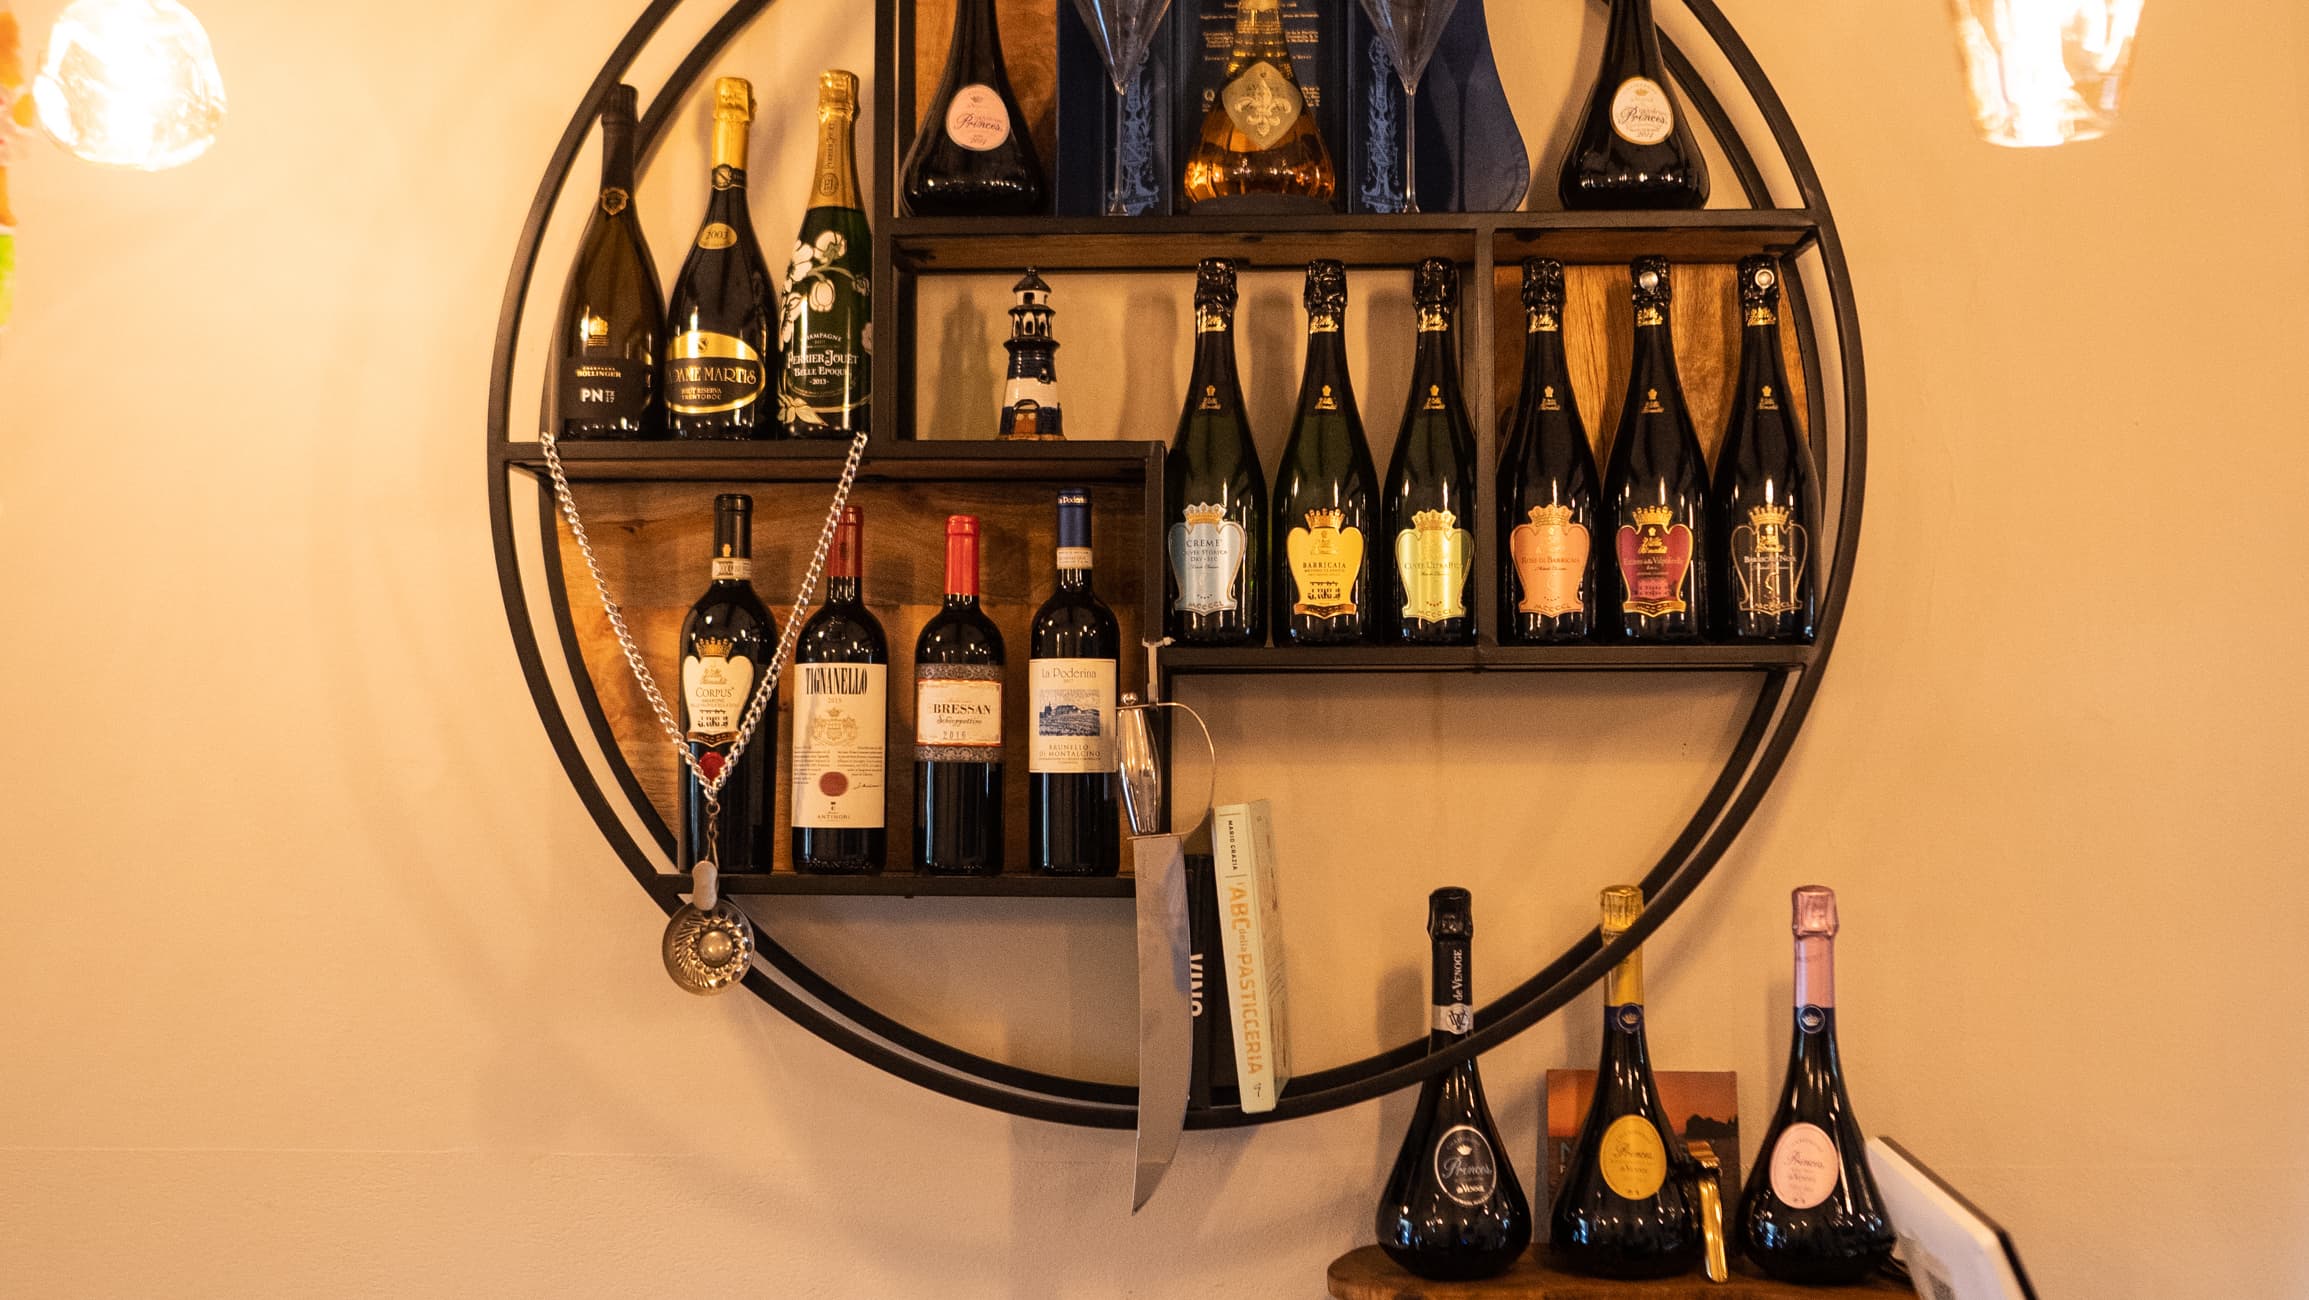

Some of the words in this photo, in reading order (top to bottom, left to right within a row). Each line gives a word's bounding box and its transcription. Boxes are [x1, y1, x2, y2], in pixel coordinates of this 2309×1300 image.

[576, 369, 621, 377] BOLLINGER
[704, 366, 757, 385] MARTIS
[794, 367, 817, 377] BELLE
[581, 388, 604, 402] PN
[1041, 668, 1050, 679] La
[1053, 667, 1097, 679] Poderina
[806, 667, 868, 695] TIGNANELLO
[696, 687, 733, 697] CORPUS
[933, 703, 991, 714] BRESSAN
[1238, 953, 1263, 1075] PASTICCERIA
